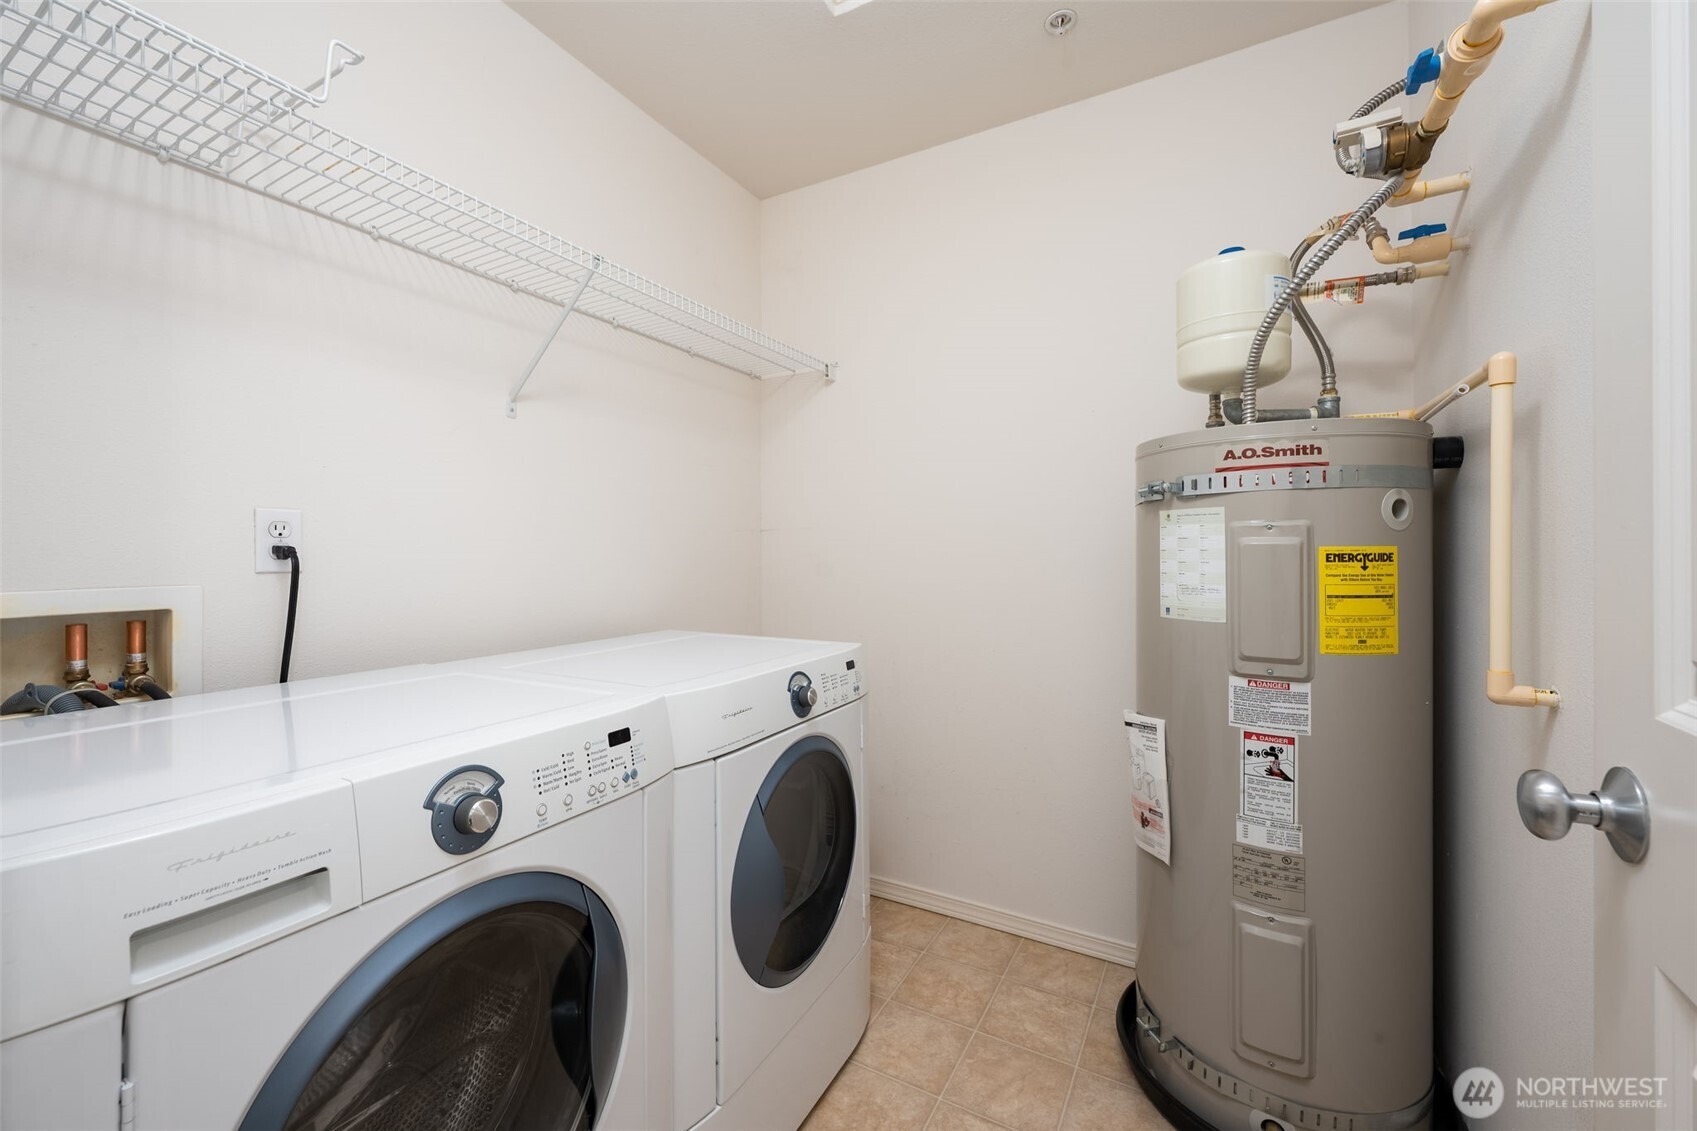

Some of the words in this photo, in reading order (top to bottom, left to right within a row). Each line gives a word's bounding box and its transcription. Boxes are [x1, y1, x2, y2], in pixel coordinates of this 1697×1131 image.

[1325, 552, 1394, 564] ENERGYGUIDE
[1256, 681, 1289, 689] DANGER
[1259, 735, 1288, 744] DANGER
[166, 832, 297, 873] Frigidaire
[123, 910, 141, 919] Easy
[142, 900, 173, 913] Loading
[180, 892, 200, 902] Super
[201, 882, 230, 894] Capacity
[237, 874, 256, 883] Heavy
[257, 868, 271, 877] Duty
[278, 860, 298, 869] Tumble
[300, 854, 317, 862] Action
